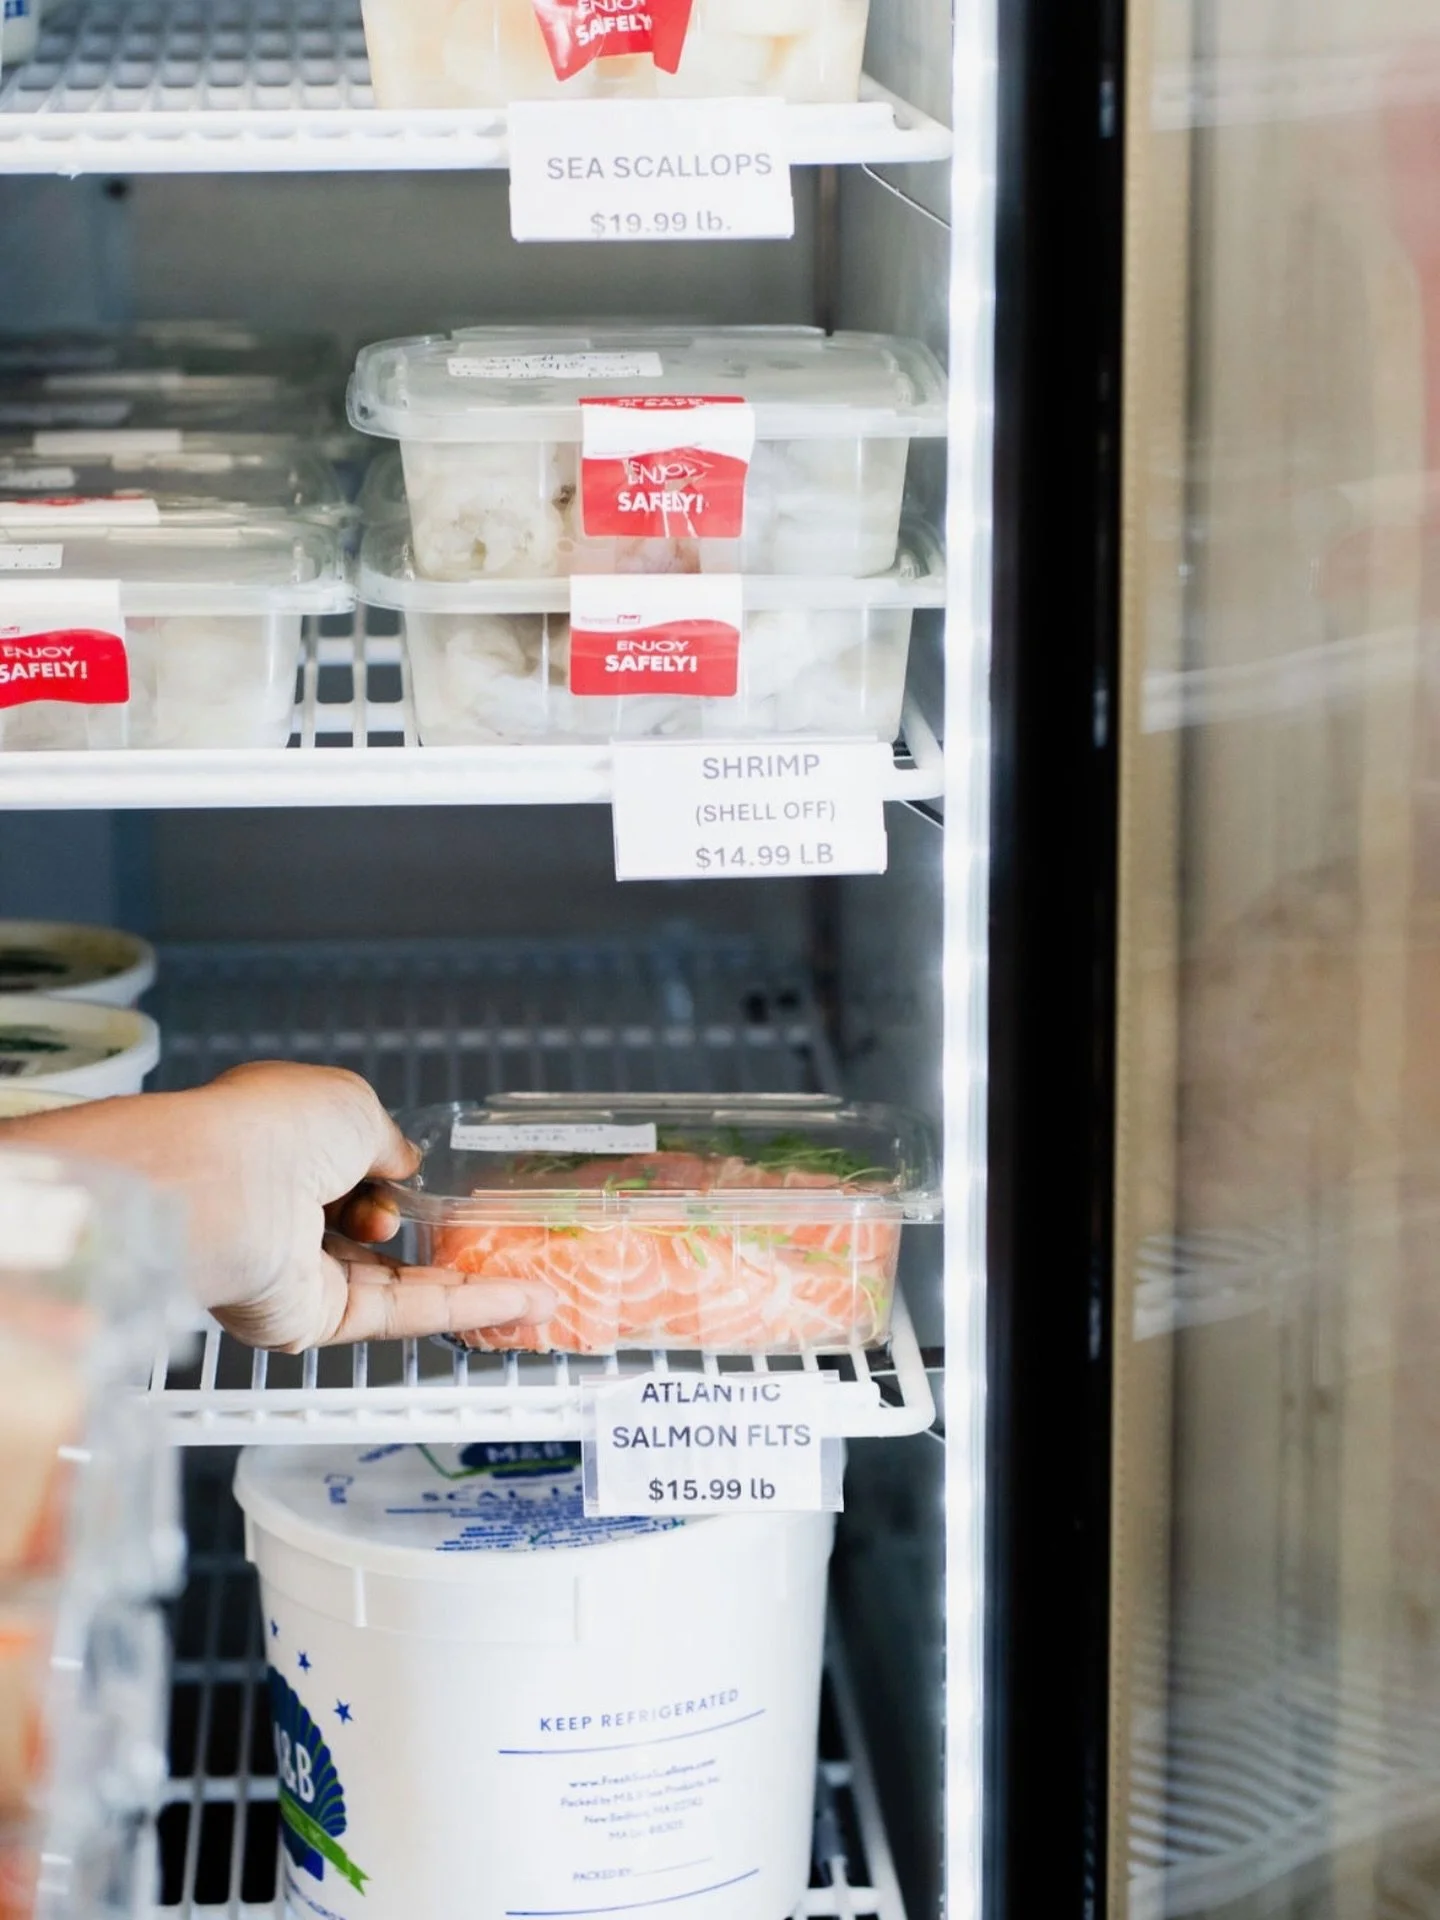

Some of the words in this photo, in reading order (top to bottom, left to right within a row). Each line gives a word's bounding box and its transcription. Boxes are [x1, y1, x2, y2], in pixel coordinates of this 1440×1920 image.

[577, 0, 647, 17] ENJO
[547, 156, 605, 180] SEA
[613, 152, 773, 179] SCALLOPS
[590, 211, 688, 236] $19.99
[696, 210, 732, 232] lb.
[628, 462, 698, 485] ENJOY
[2, 646, 75, 659] ENJOY
[616, 640, 689, 653] ENJOY
[0, 660, 88, 684] SAFELY!
[604, 654, 698, 673] SAFELY!
[702, 753, 820, 780] SHRIMP
[695, 802, 776, 826] (SHELL
[783, 800, 836, 823] OFF)
[695, 845, 791, 869] $14.99
[800, 842, 834, 865] LB
[612, 1425, 737, 1449] SALMON
[747, 1424, 811, 1447] FLTS
[648, 1477, 742, 1503] $15.99
[750, 1478, 776, 1500] lb
[540, 1716, 592, 1732] KEEP
[601, 1688, 740, 1728] REFRIGERATED
